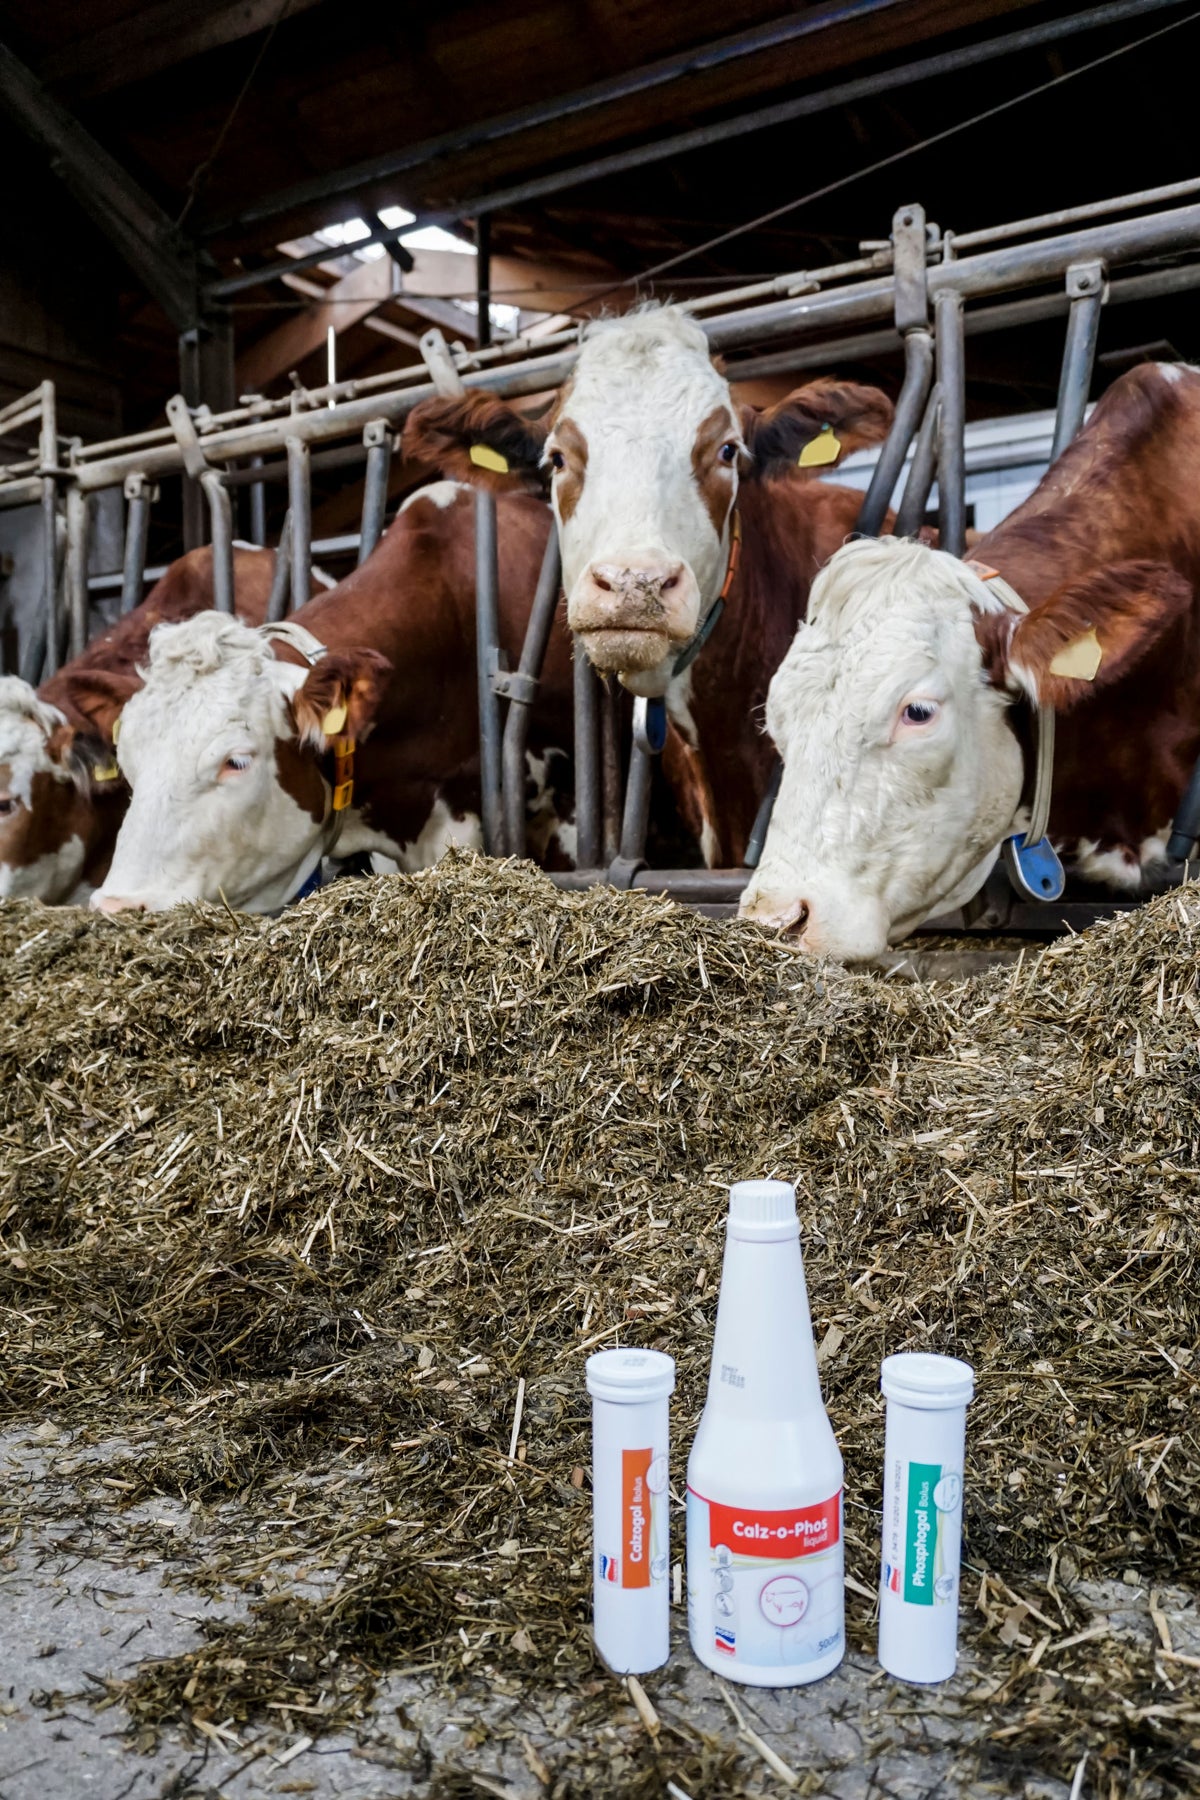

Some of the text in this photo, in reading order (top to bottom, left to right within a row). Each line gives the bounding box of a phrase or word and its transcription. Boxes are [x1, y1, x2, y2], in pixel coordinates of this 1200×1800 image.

[630, 1476, 646, 1563] Calzogol Bolus
[732, 1517, 828, 1539] Calz-o-Phos
[912, 1510, 931, 1587] Phosphogol
